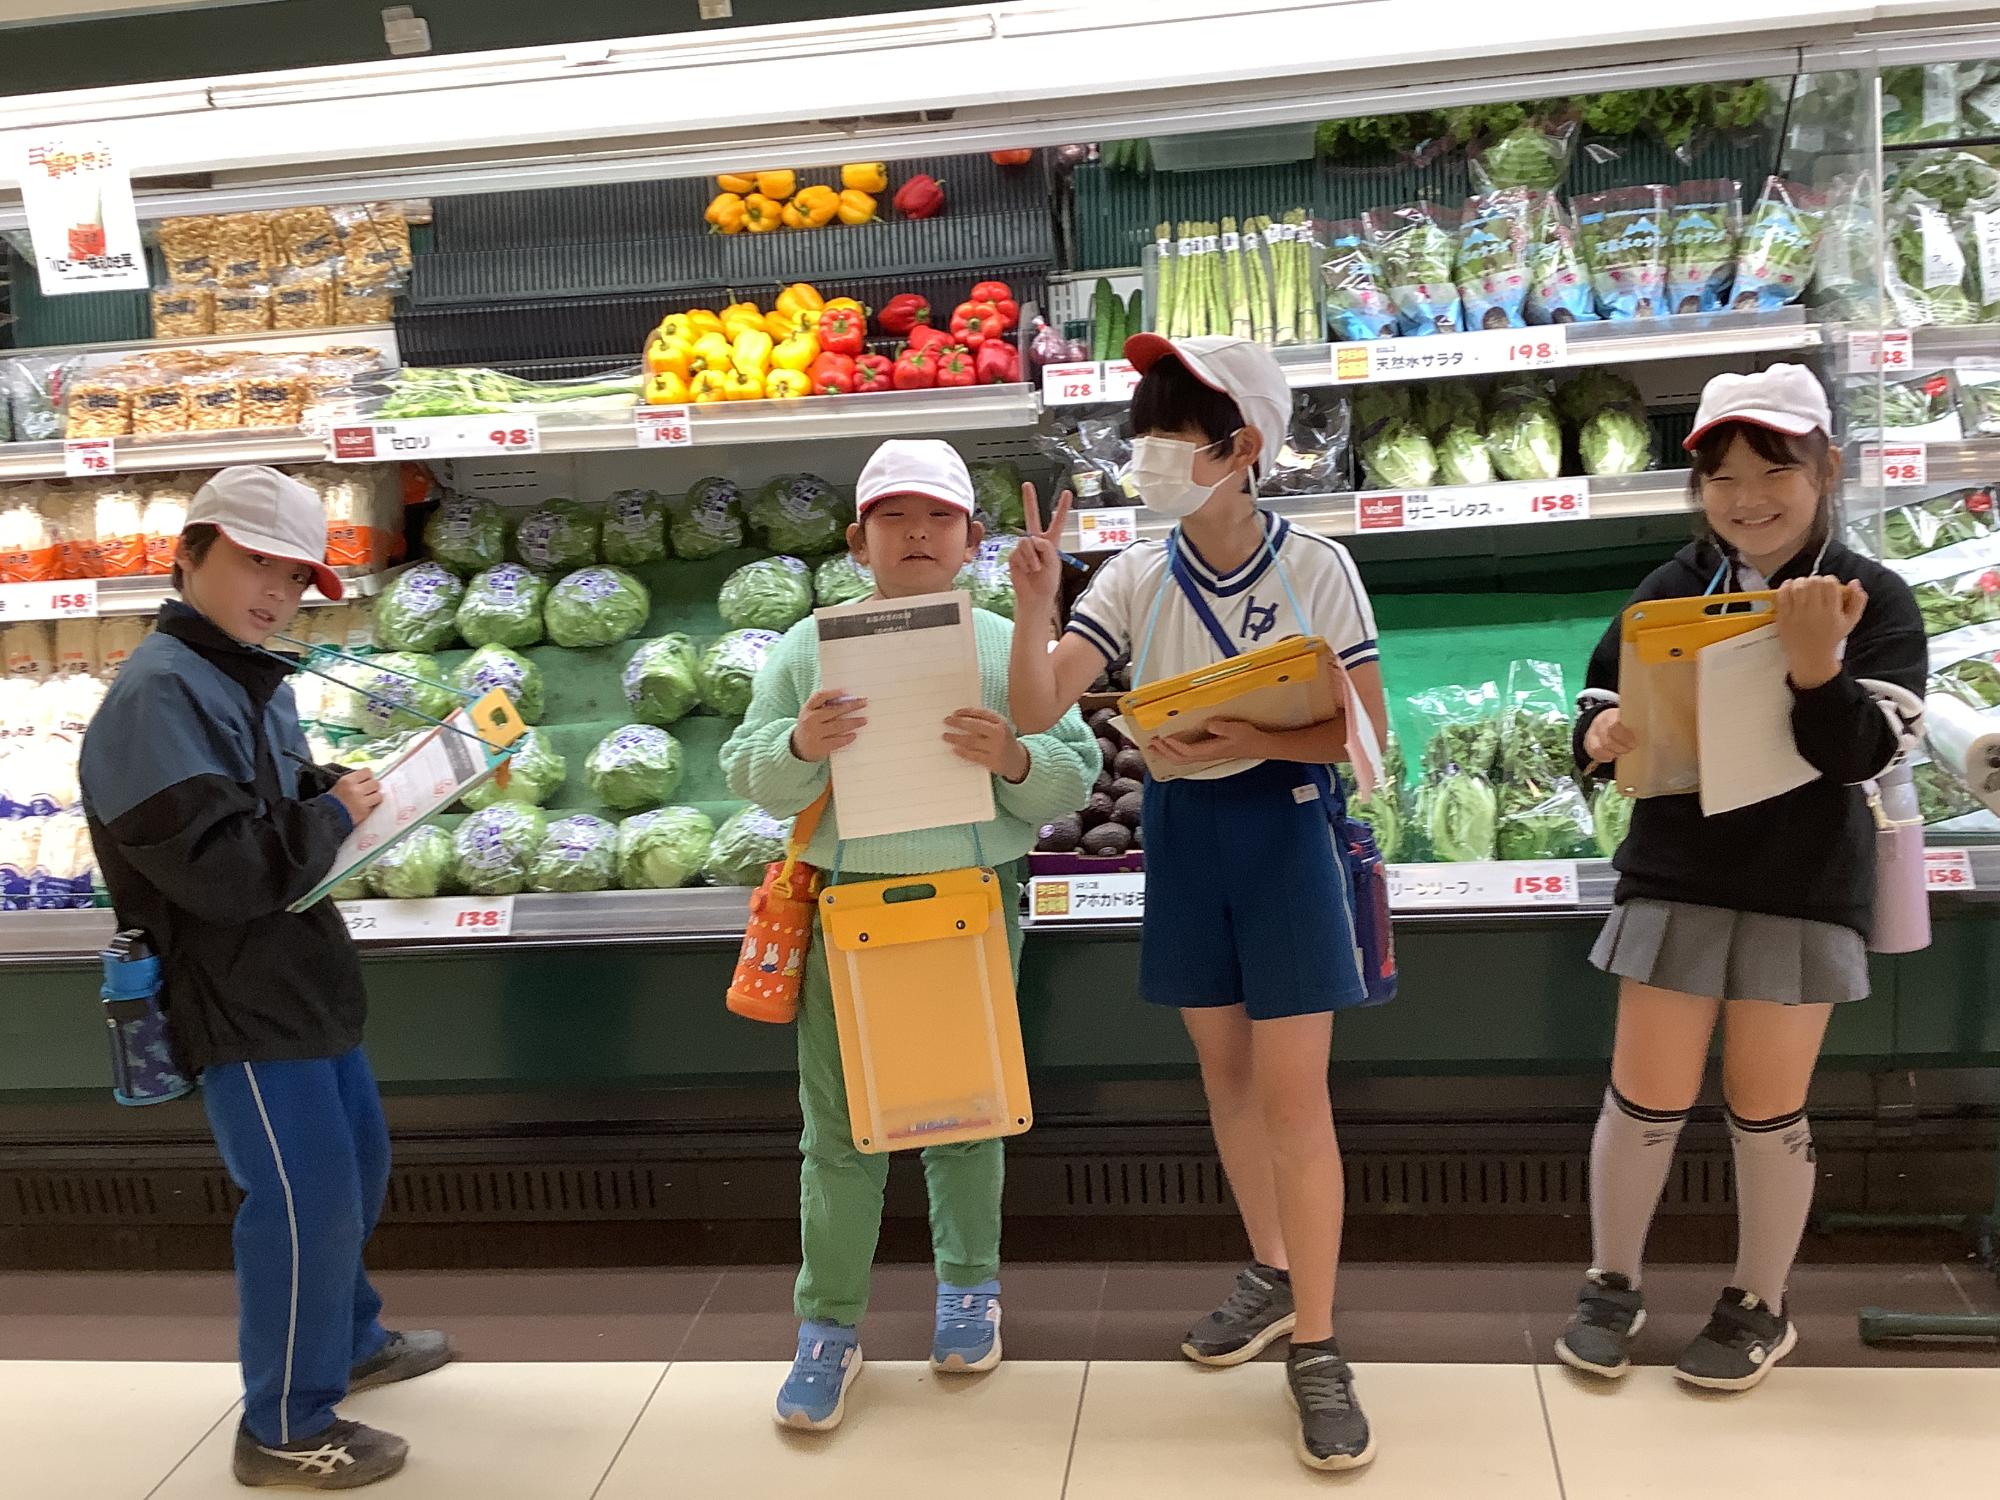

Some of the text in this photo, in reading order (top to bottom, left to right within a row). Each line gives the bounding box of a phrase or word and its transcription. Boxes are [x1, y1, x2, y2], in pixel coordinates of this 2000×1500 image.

[1508, 342, 1553, 361] 198
[1063, 383, 1093, 398] 128
[391, 429, 528, 450] セロリ 98
[654, 427, 685, 441] 198
[82, 456, 108, 469] 78
[1885, 464, 1917, 479] 98
[1406, 502, 1493, 520] サニーレタス
[1530, 494, 1576, 513] 158
[1098, 530, 1131, 544] 398
[51, 593, 88, 609] 158
[1930, 869, 1963, 883] 158
[1514, 876, 1562, 894] 158
[454, 910, 499, 927] 138
